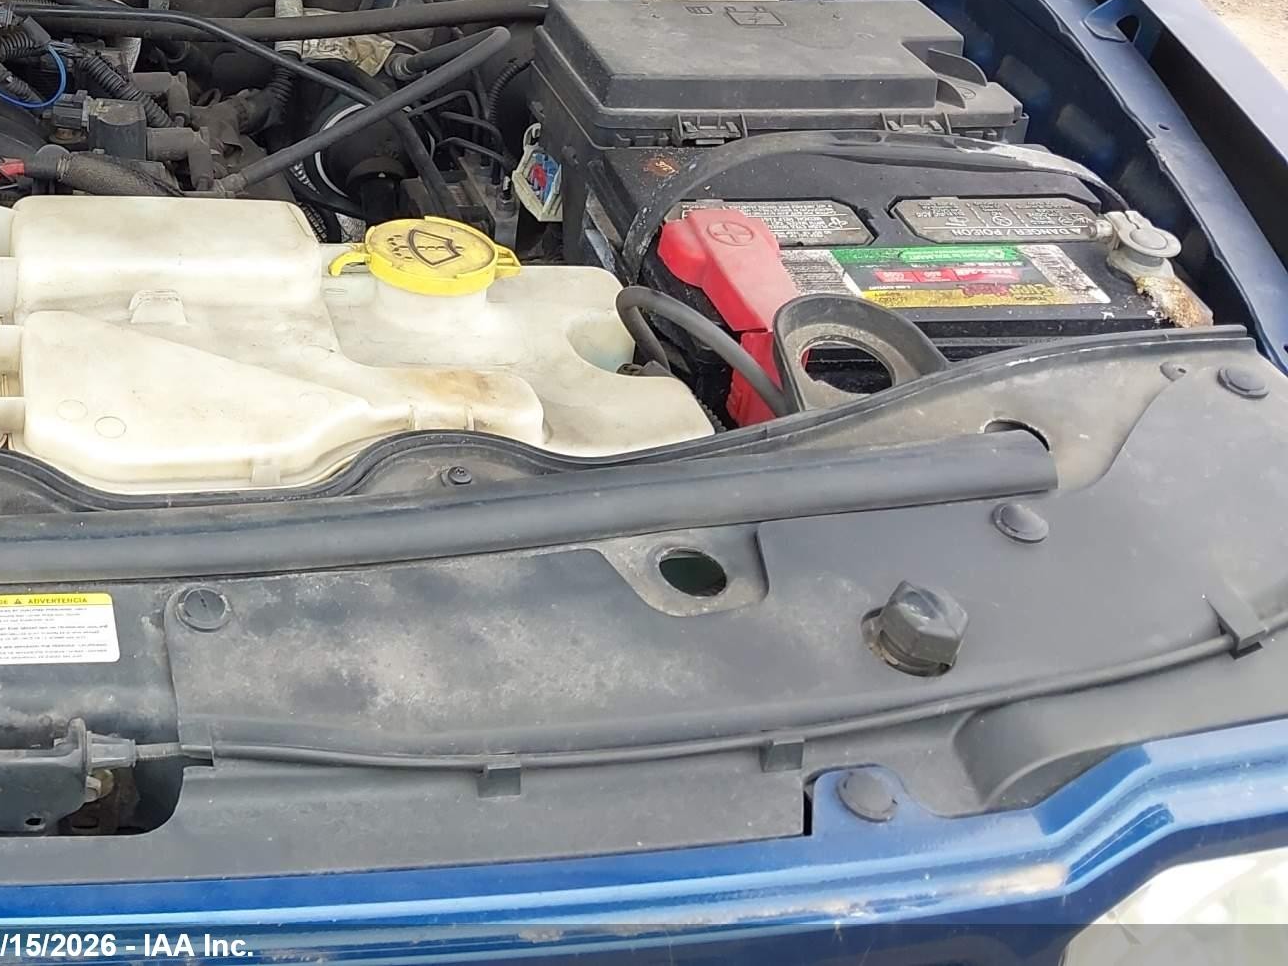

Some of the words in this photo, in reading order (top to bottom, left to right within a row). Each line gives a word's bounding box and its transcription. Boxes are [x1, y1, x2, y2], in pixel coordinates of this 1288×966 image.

[951, 228, 1004, 236] POISON
[1013, 228, 1071, 236] DANGER
[27, 597, 88, 605] ADVERTENCIA
